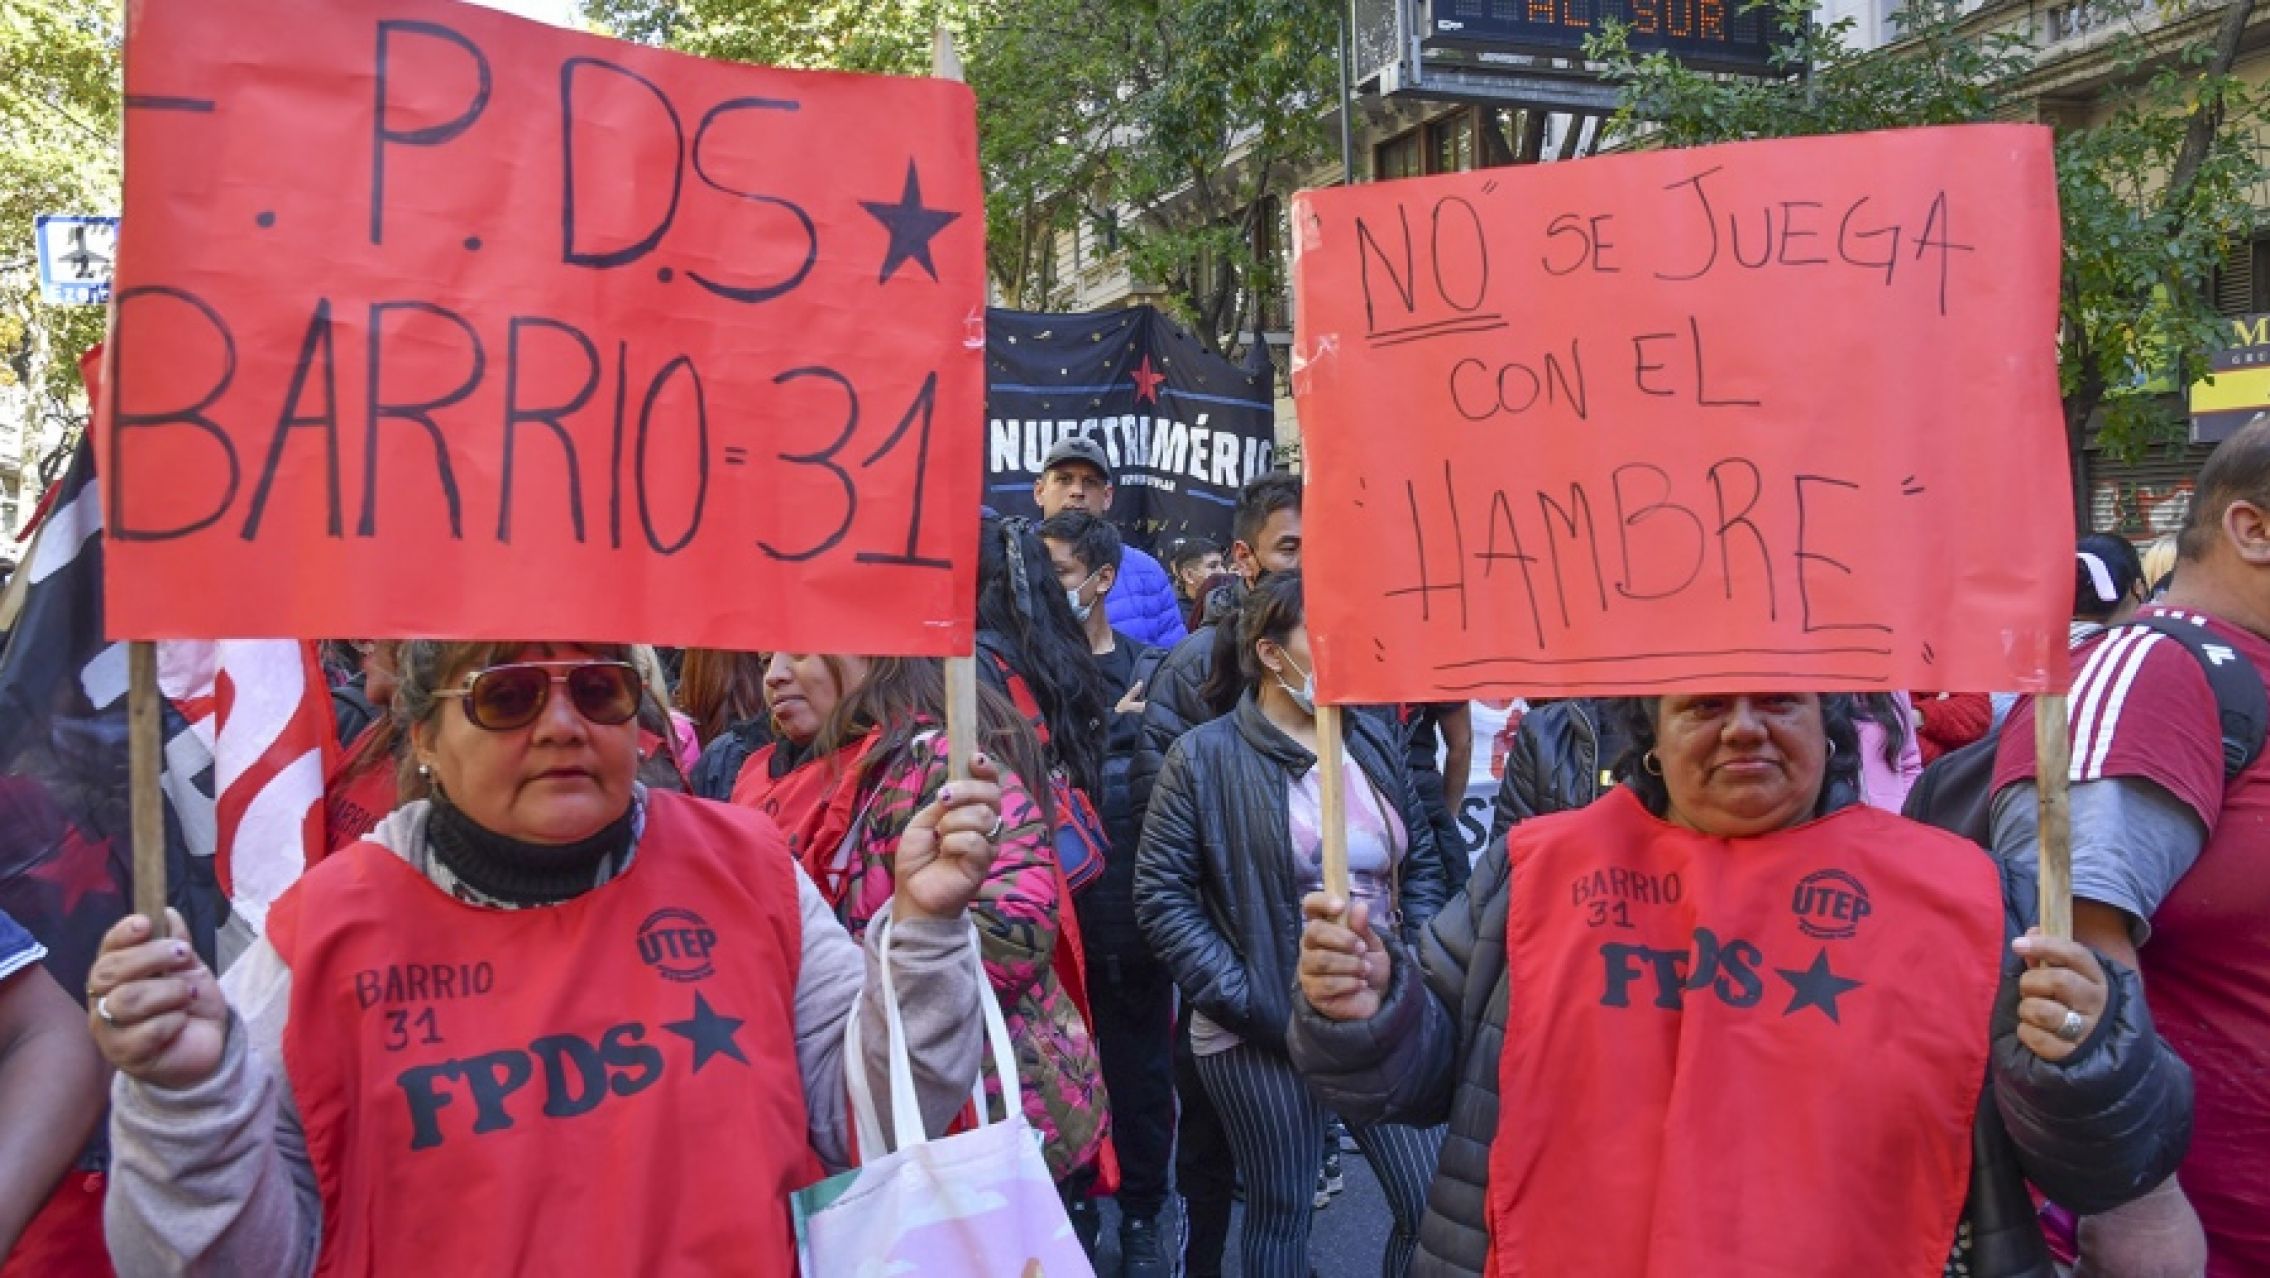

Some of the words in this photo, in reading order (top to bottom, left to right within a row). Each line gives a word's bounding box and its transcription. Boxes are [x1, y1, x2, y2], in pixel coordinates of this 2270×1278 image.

[1527, 0, 1590, 26] AL
[1633, 0, 1725, 41] SUR
[1542, 213, 1621, 275] SE
[1654, 166, 1975, 316] JUEGA
[1450, 338, 1587, 420] CON
[1633, 315, 1761, 407] EL
[1572, 868, 1682, 906] BARRIO
[1792, 884, 1870, 922] UTEP
[1587, 901, 1635, 928] 31
[637, 929, 716, 965] UTEP
[355, 961, 495, 1011] BARRIO
[384, 1008, 443, 1051] 31
[396, 1022, 664, 1151] FPDS
